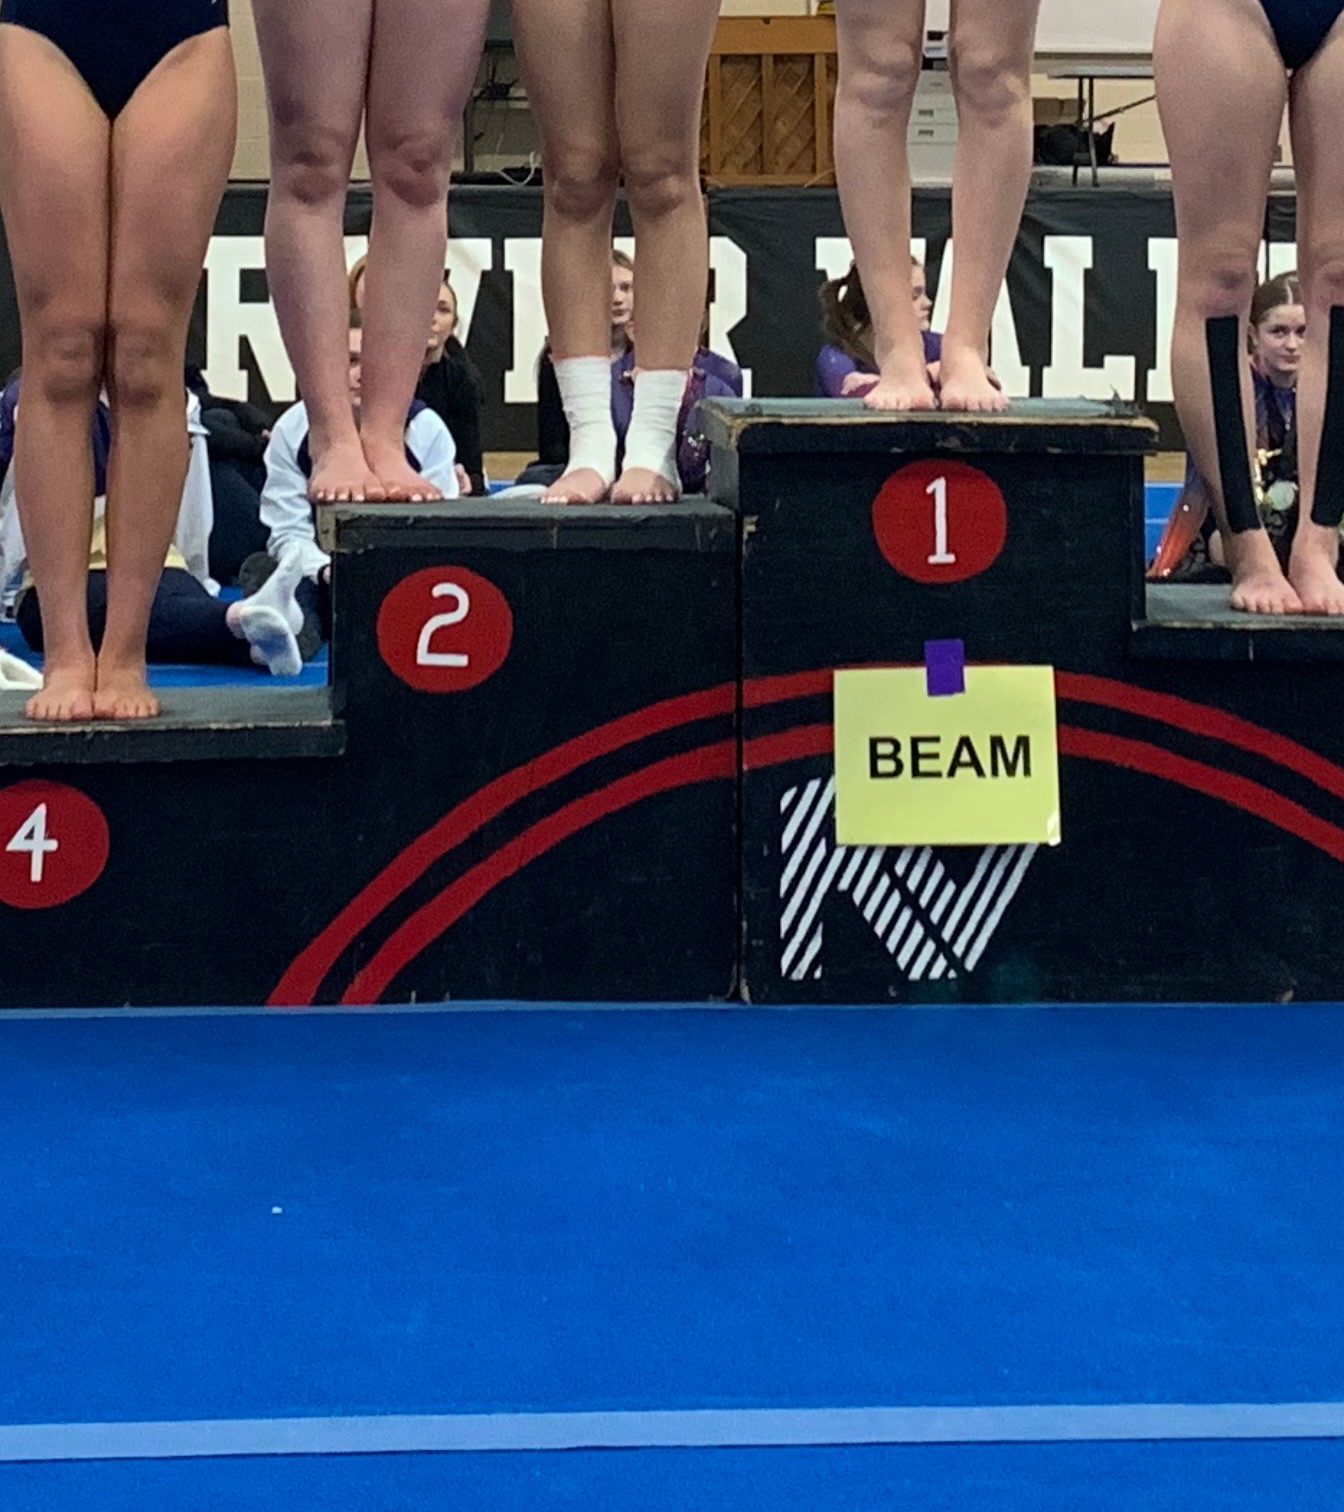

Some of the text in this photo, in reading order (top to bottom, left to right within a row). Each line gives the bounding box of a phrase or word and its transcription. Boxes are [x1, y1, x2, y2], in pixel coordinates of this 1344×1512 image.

[925, 476, 956, 564] 1
[416, 581, 470, 667] 2
[868, 734, 1032, 780] BEAM
[5, 801, 59, 883] 4
